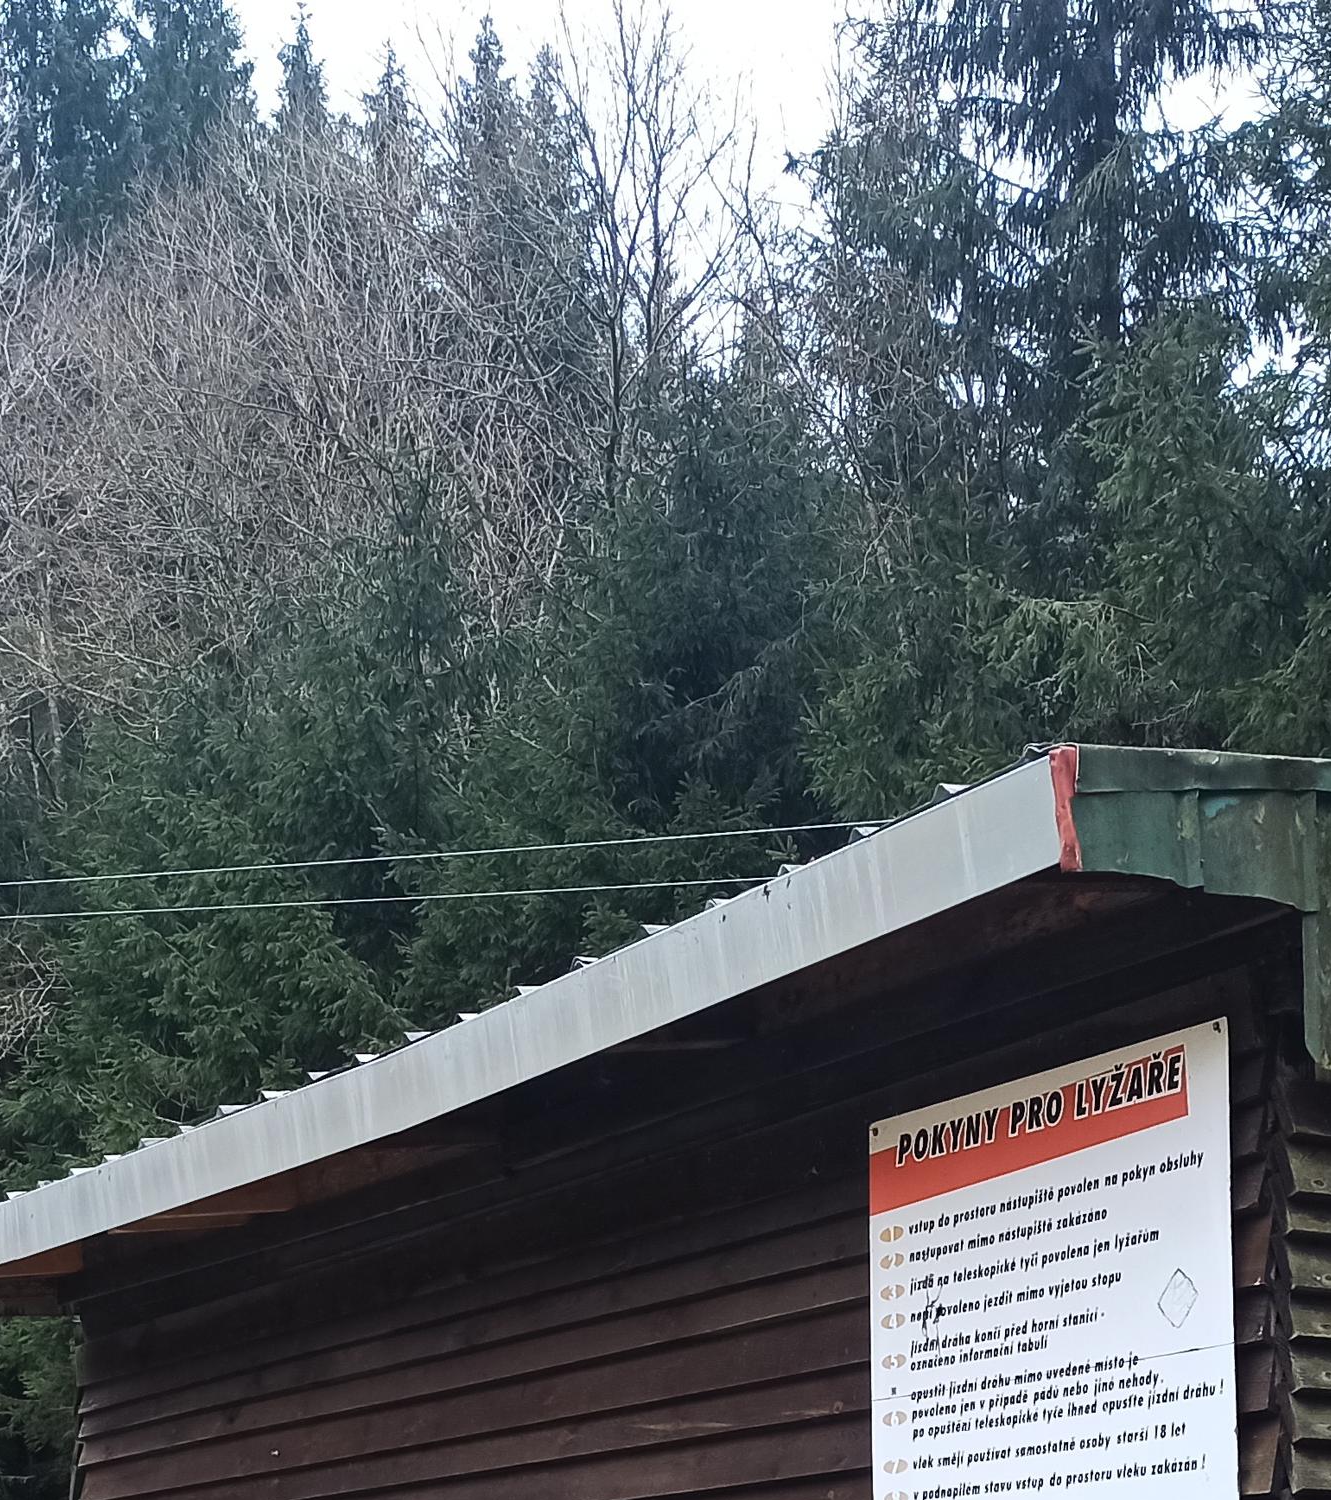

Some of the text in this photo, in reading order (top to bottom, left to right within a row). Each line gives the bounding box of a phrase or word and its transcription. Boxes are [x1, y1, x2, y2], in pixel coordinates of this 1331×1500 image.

[896, 1051, 1183, 1165] POKYNY PRO LYŽAŘE
[908, 1219, 935, 1236] vstup
[937, 1212, 951, 1230] do
[952, 1203, 997, 1229] prostoru
[999, 1185, 1055, 1214] nástupiště
[1056, 1176, 1100, 1204] povolen
[1104, 1173, 1119, 1188] na
[1121, 1163, 1156, 1188] pokyn
[1159, 1149, 1204, 1174] obsluhy
[908, 1238, 965, 1263] nastupovat
[967, 1232, 996, 1251] mimo
[998, 1217, 1053, 1244] nástupiště
[1055, 1207, 1108, 1231] zakázáno
[937, 1275, 951, 1287] na
[952, 1256, 1017, 1284] teleskopické
[1040, 1244, 1090, 1270] povolena
[1092, 1237, 1111, 1259] jen
[982, 1289, 1013, 1313] jezdit
[1016, 1284, 1045, 1303] mimo
[1048, 1278, 1088, 1298] vyjetou
[1091, 1271, 1122, 1290] stopu
[941, 1331, 972, 1349] dráha
[1003, 1322, 1028, 1342] před
[1030, 1314, 1060, 1334] horní
[910, 1350, 956, 1372] označeno
[910, 1382, 946, 1405] opustit
[980, 1373, 1011, 1391] dráhu
[1013, 1368, 1043, 1386] mimo
[1045, 1358, 1091, 1380] uvedené
[1094, 1355, 1125, 1373] místo
[1127, 1350, 1139, 1372] je
[911, 1401, 957, 1424] povoleno
[959, 1397, 976, 1417] jen
[979, 1399, 986, 1410] v
[988, 1389, 1029, 1413] případě
[1062, 1380, 1089, 1398] nebo
[912, 1427, 925, 1443] po
[974, 1407, 1039, 1431] teleskopické
[1042, 1405, 1064, 1425] tyče
[1067, 1398, 1098, 1418] ihned
[1182, 1381, 1216, 1401] dráhu
[912, 1454, 934, 1470] vlek
[1014, 1436, 1076, 1458] samostatně
[1079, 1432, 1111, 1451] osoby
[1154, 1423, 1167, 1440] 18
[1170, 1421, 1186, 1438] let
[913, 1491, 920, 1500] v
[984, 1480, 1013, 1494] stavu
[1015, 1476, 1044, 1492] vstup
[1049, 1471, 1062, 1487] do
[1065, 1469, 1113, 1489] prostoru
[1116, 1462, 1147, 1479] vleku
[1150, 1456, 1198, 1476] zakázán
